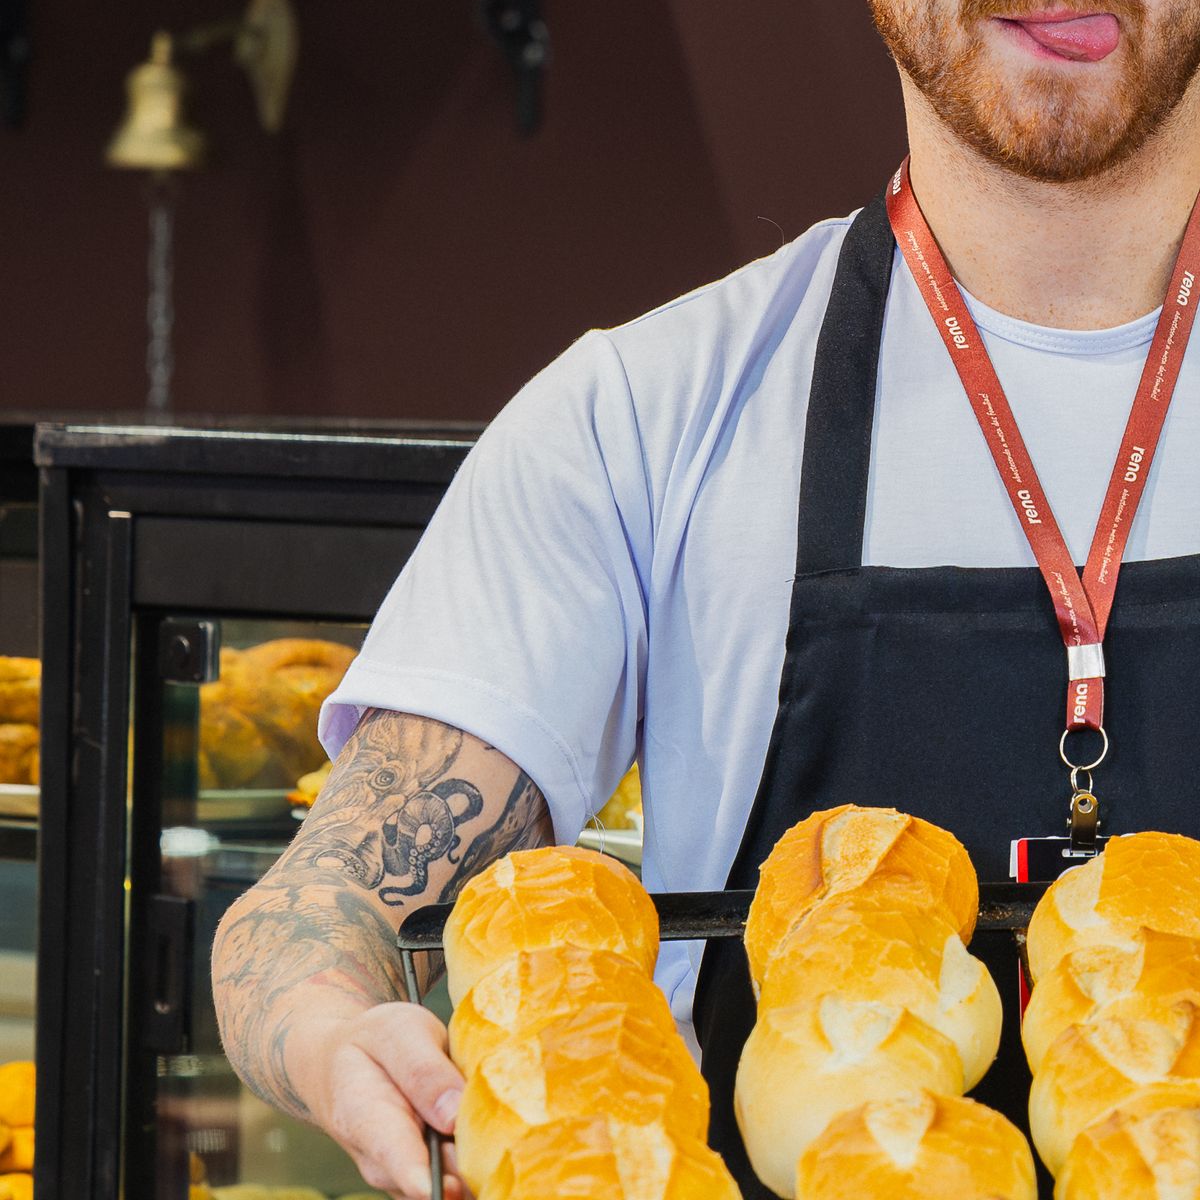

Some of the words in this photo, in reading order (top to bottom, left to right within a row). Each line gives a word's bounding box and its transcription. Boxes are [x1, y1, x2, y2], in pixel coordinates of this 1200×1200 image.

[1177, 270, 1195, 306] rena
[945, 316, 969, 349] rena
[1124, 445, 1145, 482] rena
[1018, 489, 1041, 524] rena
[1073, 683, 1088, 723] rena
